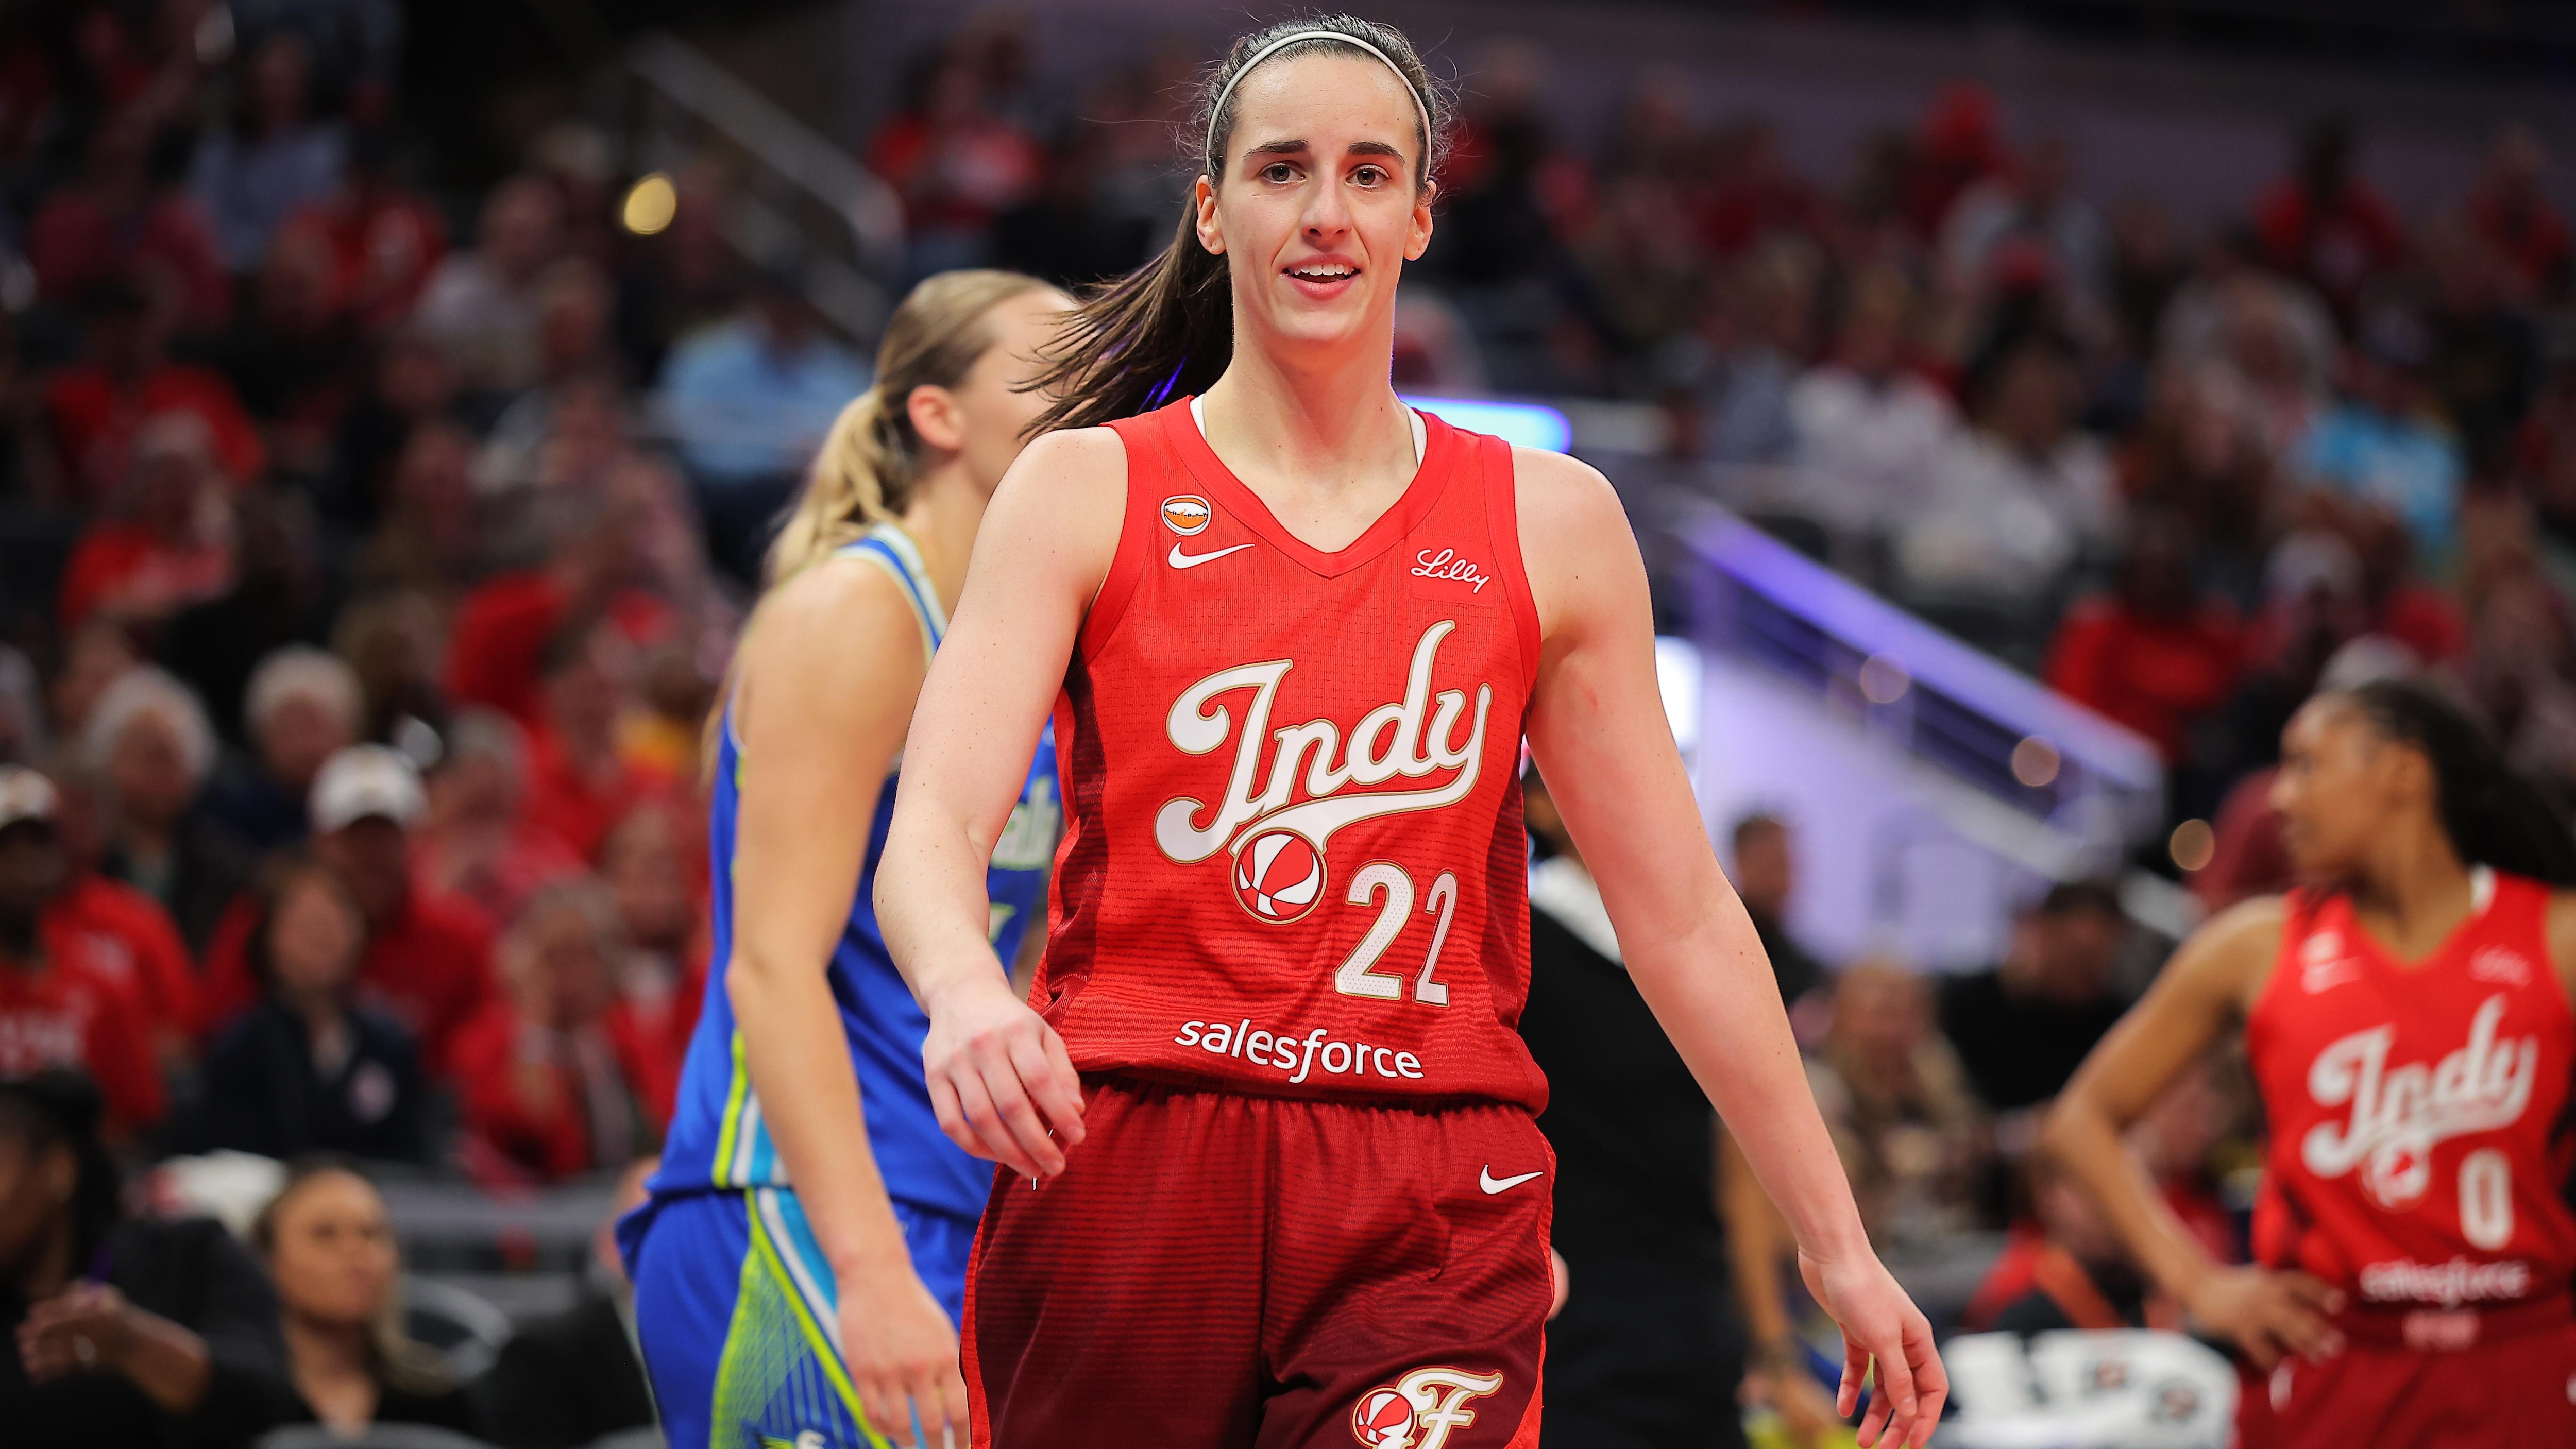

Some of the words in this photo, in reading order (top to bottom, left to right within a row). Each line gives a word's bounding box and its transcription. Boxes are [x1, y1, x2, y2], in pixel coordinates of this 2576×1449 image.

[1411, 548, 1490, 593] Lilly
[1154, 619, 1493, 864] Indy
[1333, 859, 1459, 1007] 22
[1175, 1018, 1425, 1084] salesforce
[2303, 995, 2537, 1175] Indy
[2458, 1147, 2514, 1251] 0
